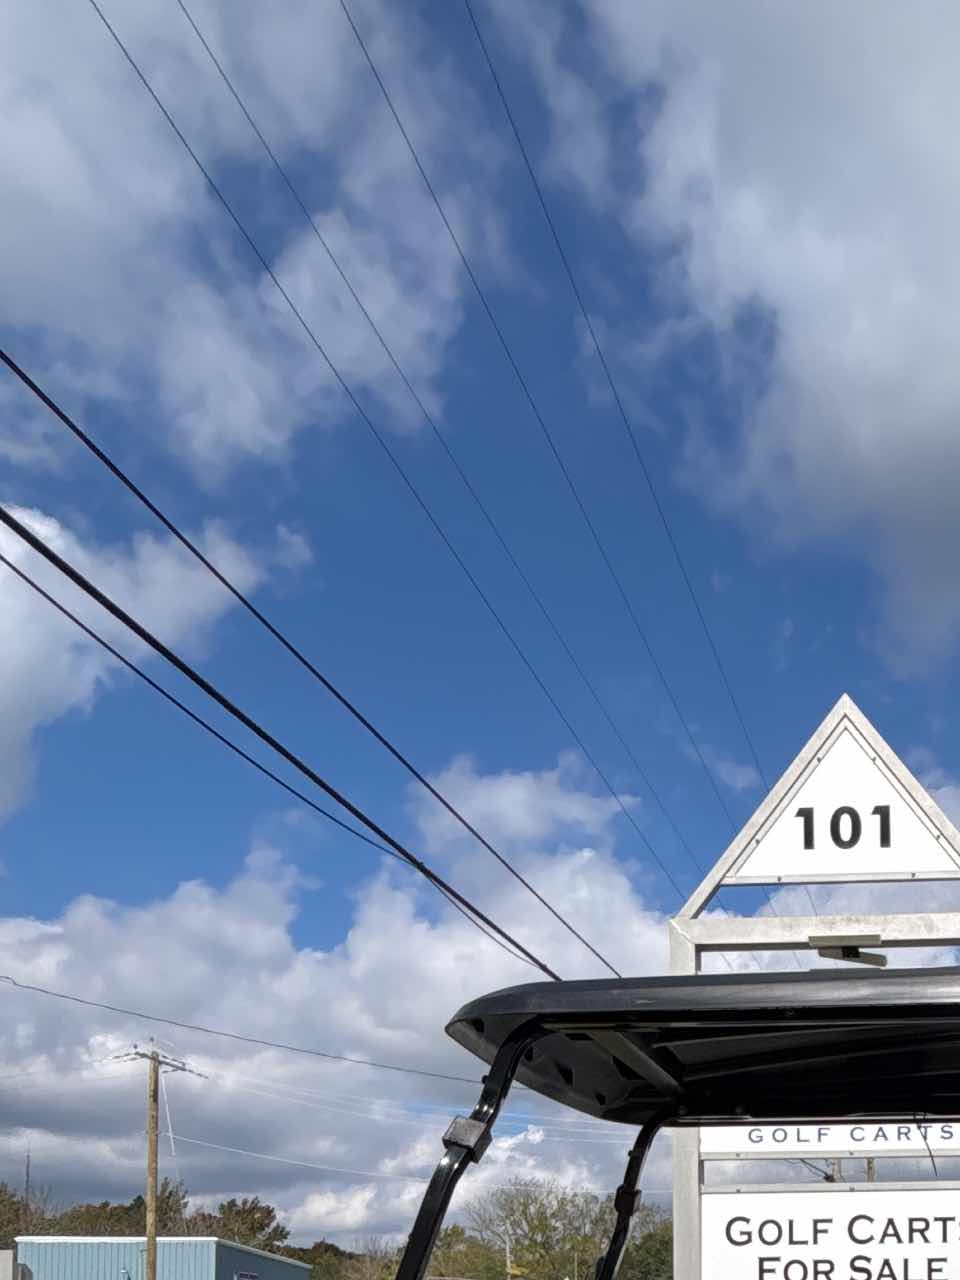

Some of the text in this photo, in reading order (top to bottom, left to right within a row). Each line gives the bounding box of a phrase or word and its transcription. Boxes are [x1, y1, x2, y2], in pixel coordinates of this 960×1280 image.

[794, 805, 892, 850] 101
[748, 1125, 954, 1144] GOLF CARTS
